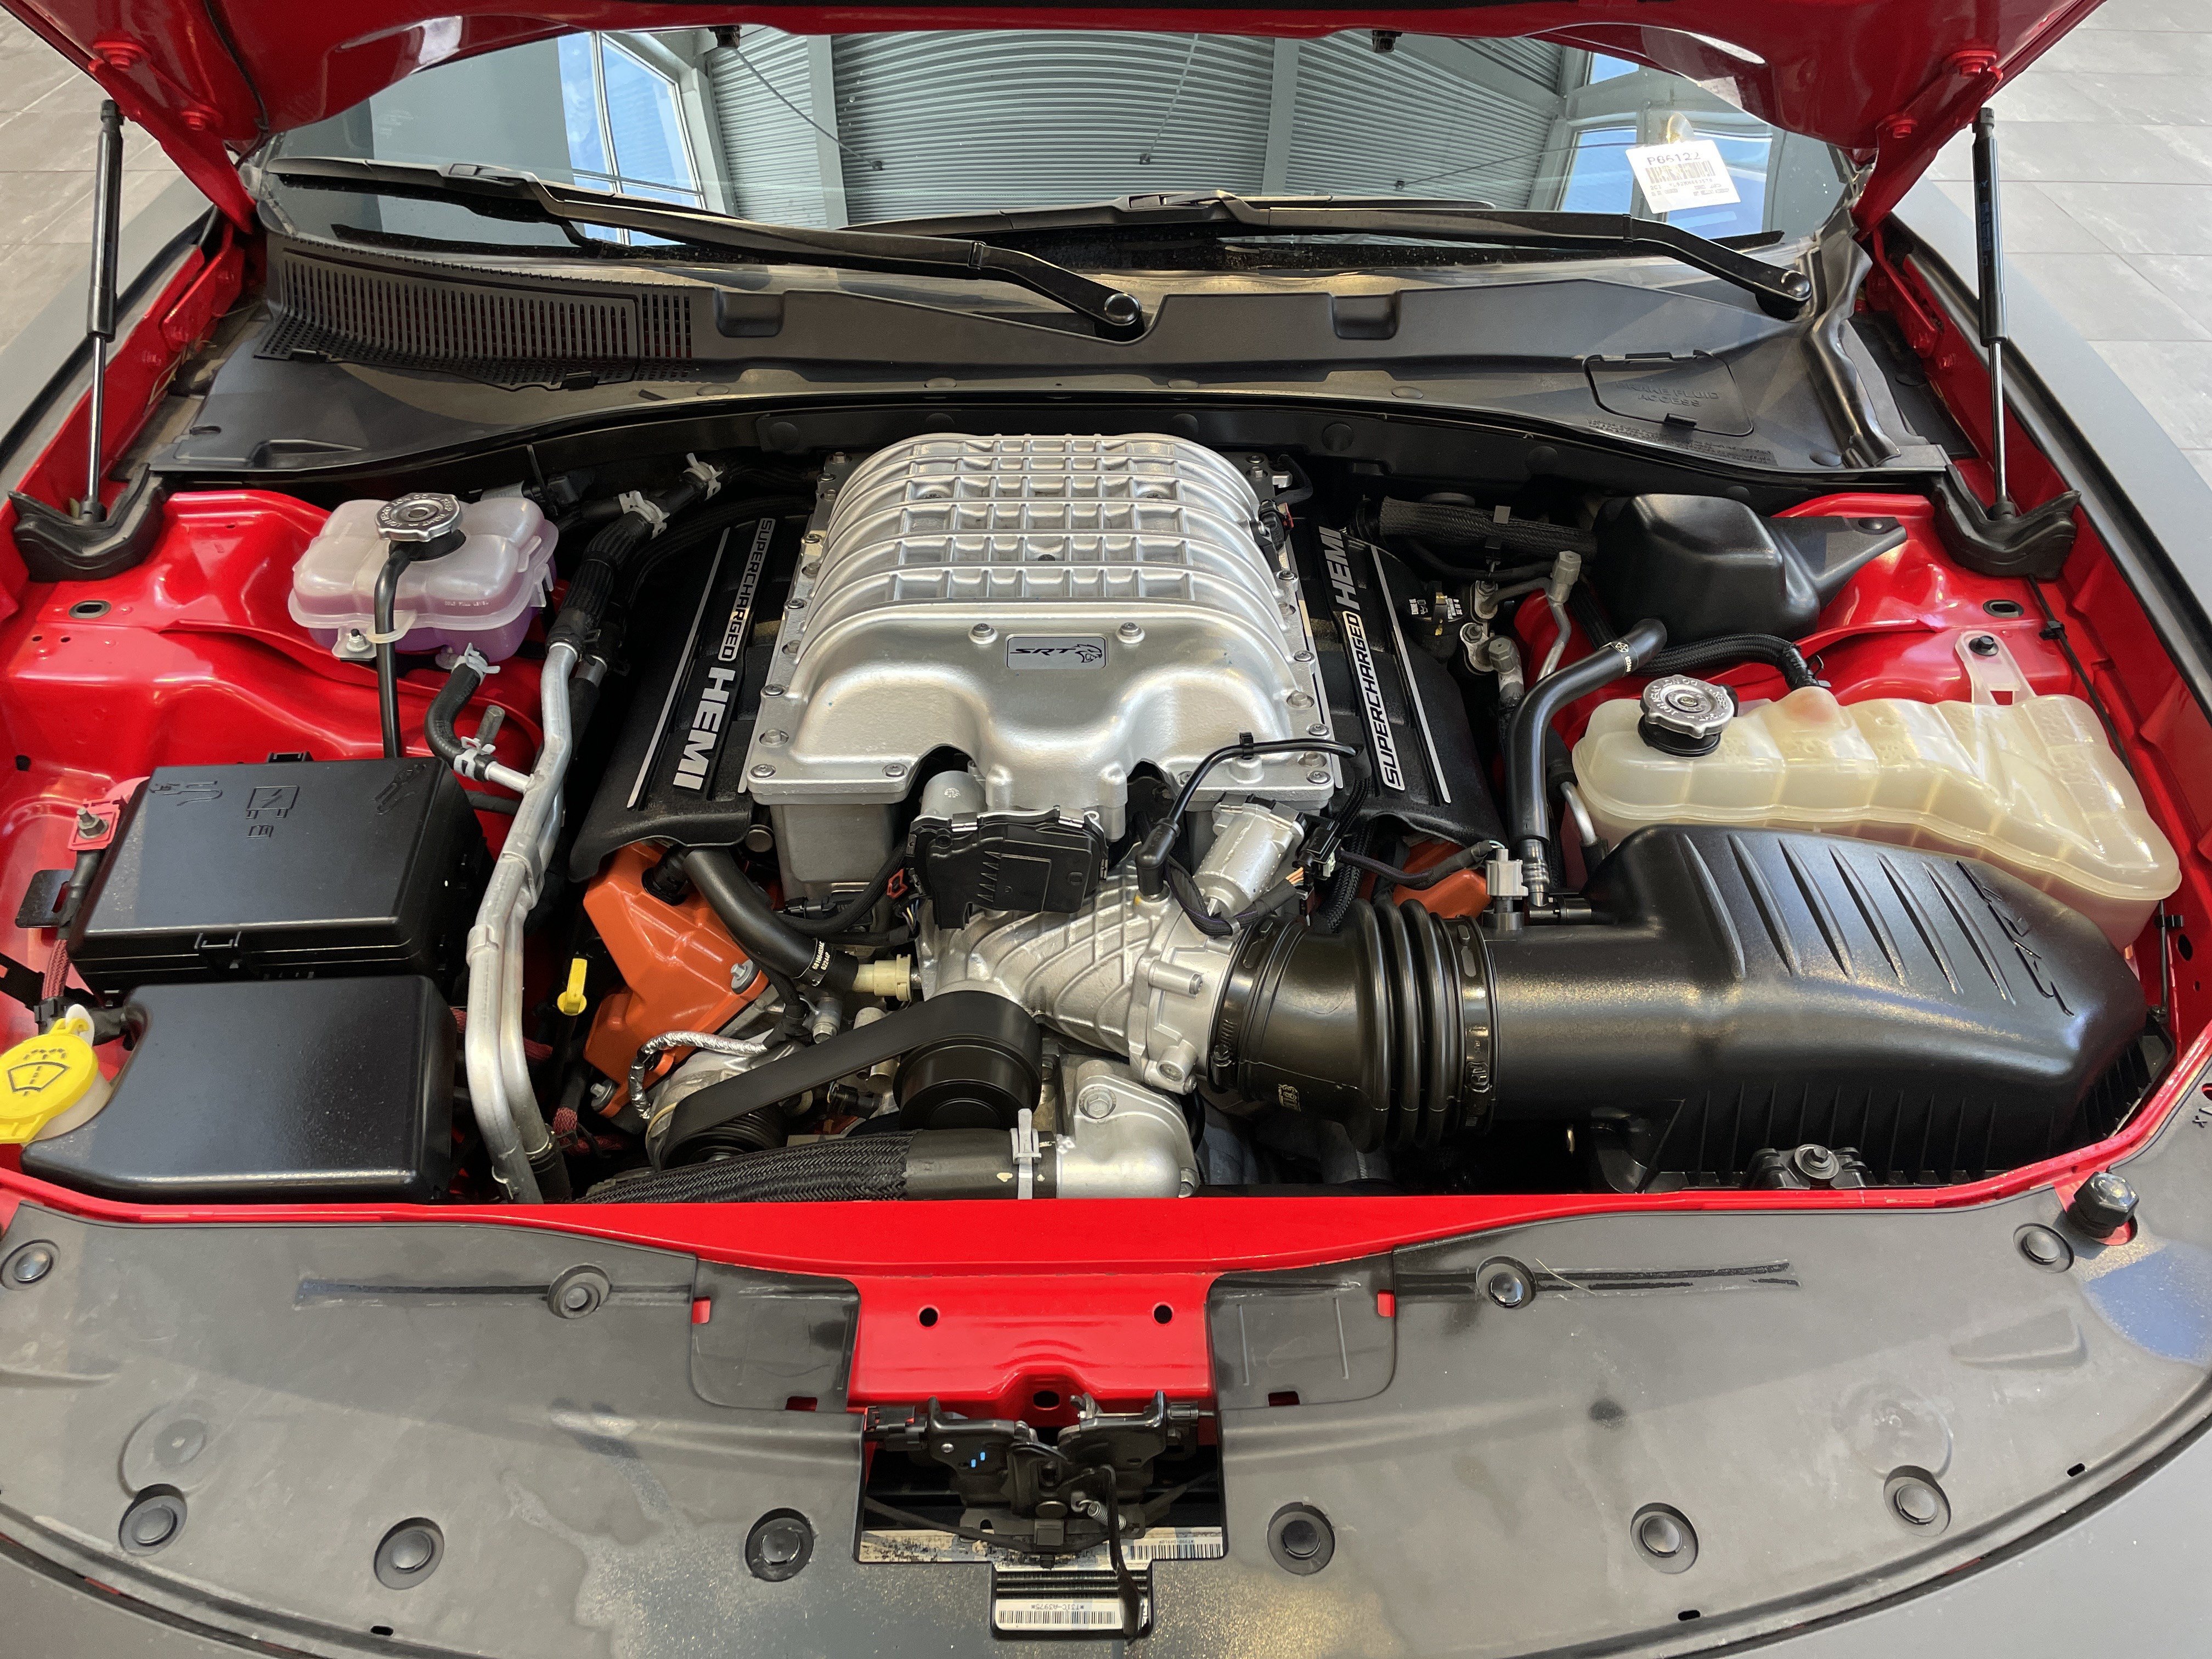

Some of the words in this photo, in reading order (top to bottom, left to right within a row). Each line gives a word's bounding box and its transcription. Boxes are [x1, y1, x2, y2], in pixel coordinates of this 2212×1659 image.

[1638, 393, 1702, 407] ACCESS
[1673, 389, 1720, 399] FLUID
[721, 520, 772, 659] SUPERCHARGED
[1319, 526, 1361, 611] HEMI
[1009, 648, 1076, 656] SRT
[673, 667, 736, 789] HEMI
[1345, 613, 1401, 787] SUPERCHARGED
